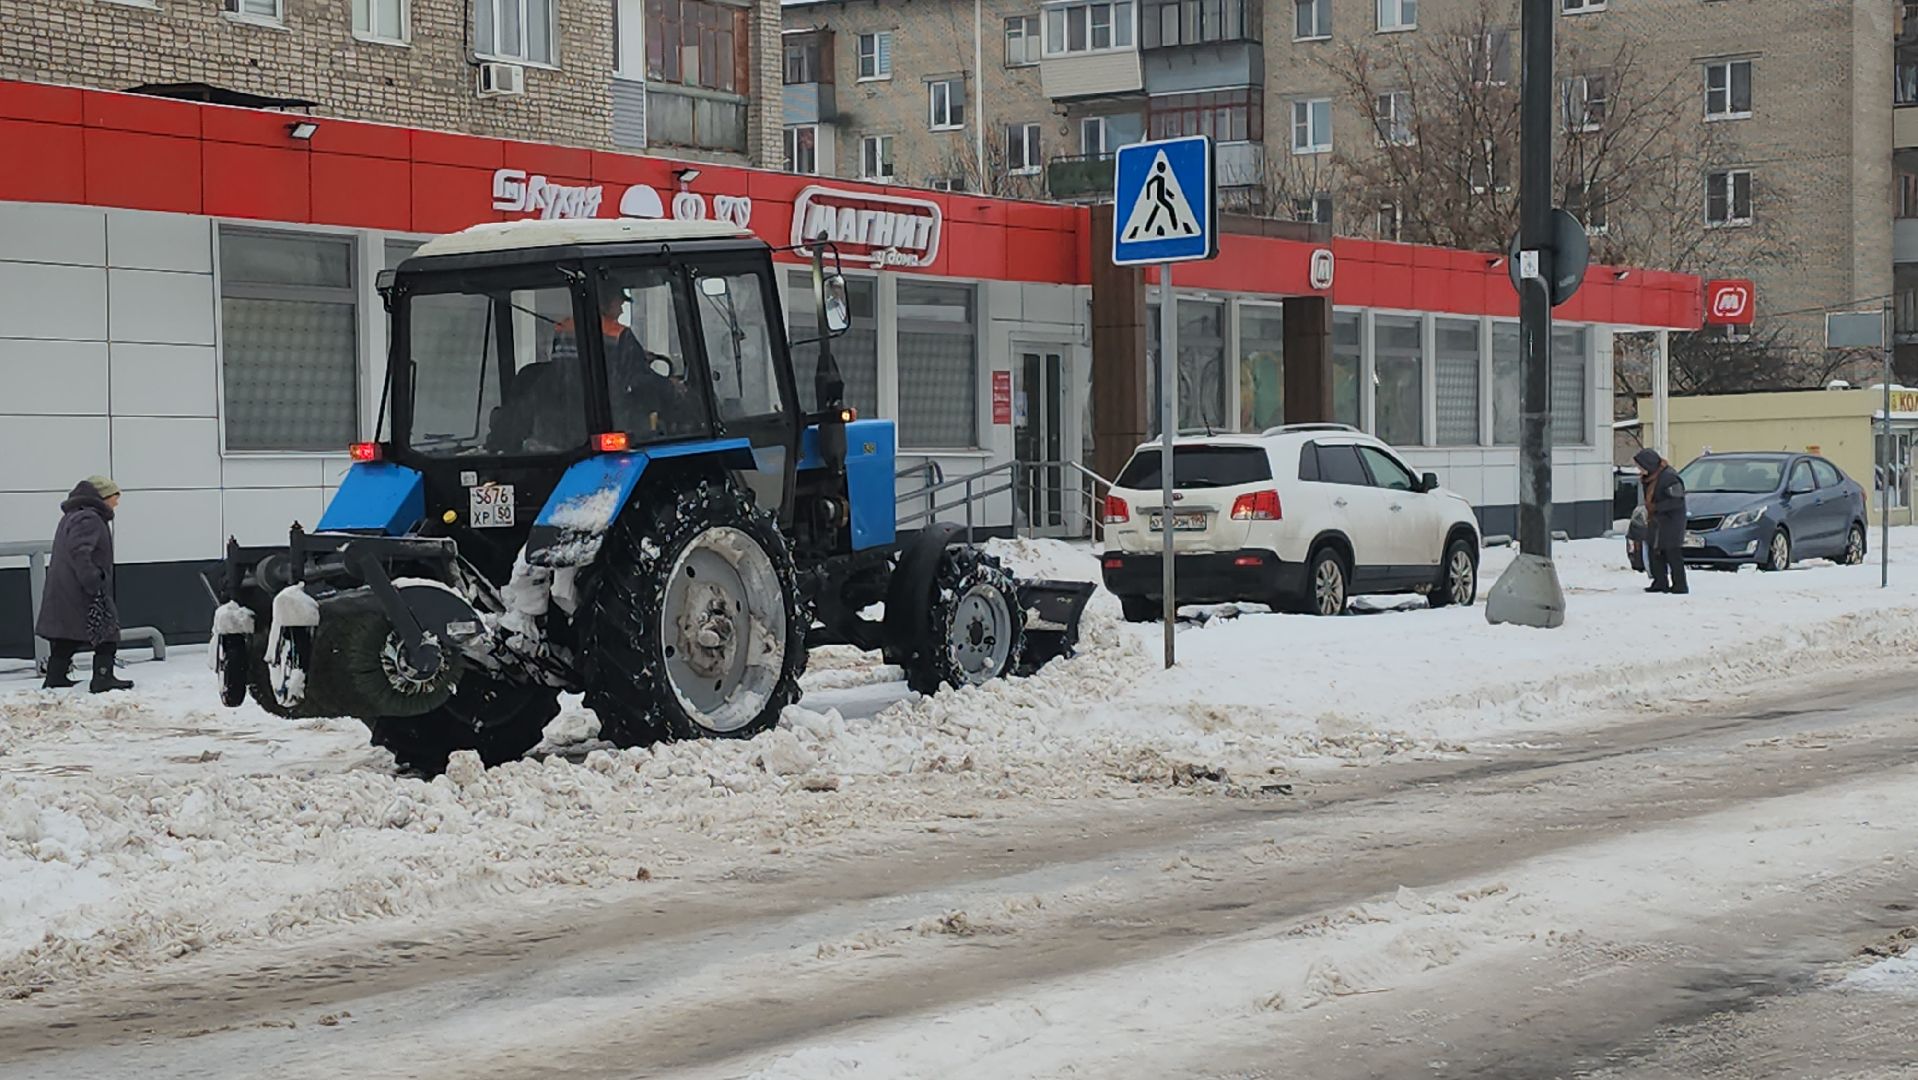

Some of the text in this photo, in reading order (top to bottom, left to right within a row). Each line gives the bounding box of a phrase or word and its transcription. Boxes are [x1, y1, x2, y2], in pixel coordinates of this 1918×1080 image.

[804, 200, 934, 250] МАГНИТ
[475, 487, 508, 504] 5676
[497, 506, 511, 519] 50
